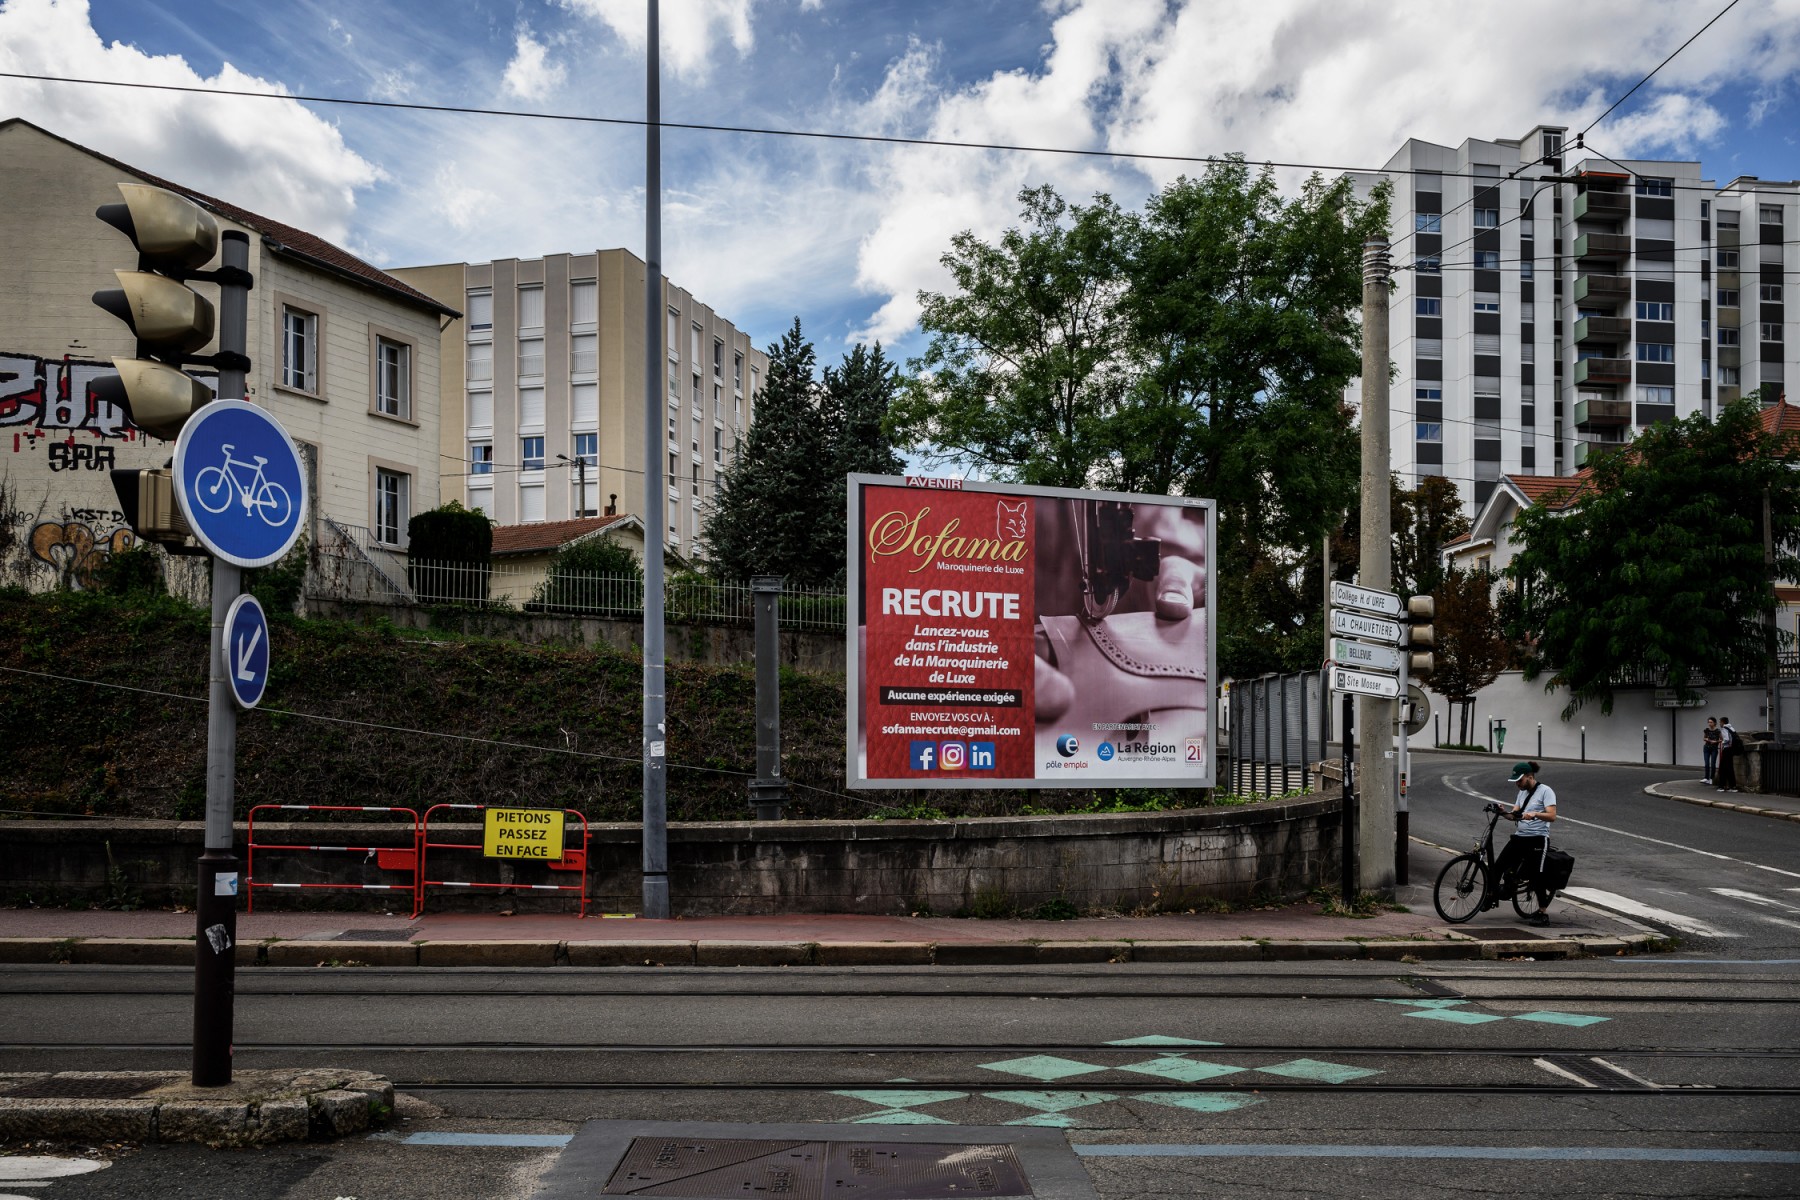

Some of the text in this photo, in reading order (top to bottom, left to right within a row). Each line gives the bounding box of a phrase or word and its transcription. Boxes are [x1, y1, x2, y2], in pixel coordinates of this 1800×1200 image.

[907, 477, 961, 490] AVENIR
[869, 506, 1029, 573] Sofama
[936, 561, 1025, 575] Maroquinerie de Luxe
[882, 587, 1020, 620] RECRUTE
[1338, 617, 1346, 628] LA
[914, 624, 989, 638] Lancez-vous
[905, 638, 999, 653] dans l'industrie
[1349, 647, 1372, 660] BELLEVUE
[894, 654, 1009, 671] de la Maroquinerie
[928, 671, 976, 684] de Luxe
[1346, 675, 1359, 687] Site
[1361, 677, 1381, 690] Mosser
[888, 690, 1015, 704] Aucune expérience exigée
[910, 712, 950, 722] ENVOYEZ
[951, 713, 970, 722] VOS
[970, 713, 982, 722] CV
[882, 724, 1021, 738] sofamarecrute@gmail.com
[972, 745, 992, 766] in
[1117, 741, 1176, 756] La Région
[1187, 745, 1201, 760] 2i
[1045, 760, 1088, 770] pôle emploi
[496, 812, 551, 824] PIETONS
[499, 828, 547, 840] PASSEZ
[496, 845, 548, 856] EN FACE
